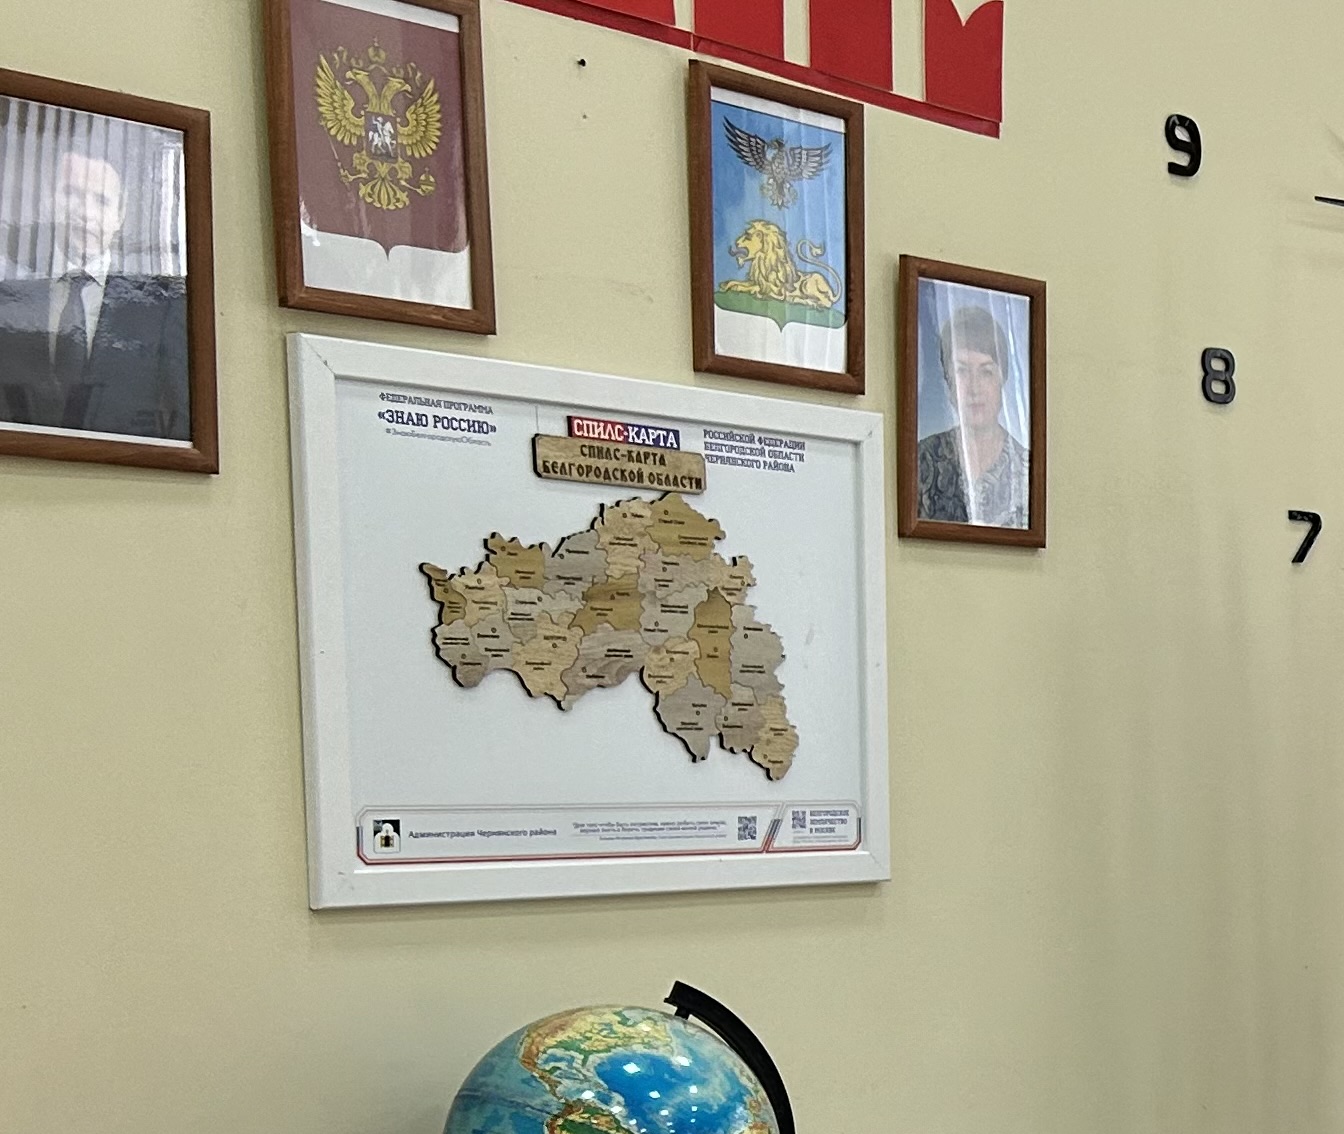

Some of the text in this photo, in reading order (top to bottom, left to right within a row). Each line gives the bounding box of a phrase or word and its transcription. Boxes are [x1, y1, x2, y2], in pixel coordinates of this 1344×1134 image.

[1165, 113, 1202, 177] 9
[1201, 347, 1236, 404] 8
[378, 409, 496, 434] «ЗНАЮ РОССИЮ»
[573, 419, 678, 449] СПИЛС-КАРТА
[580, 444, 667, 467] СПИЛС-КАРТА
[542, 460, 702, 490] БЕЛГОРОДСКОЙ ОБЛАСТИ
[1288, 509, 1322, 564] 7
